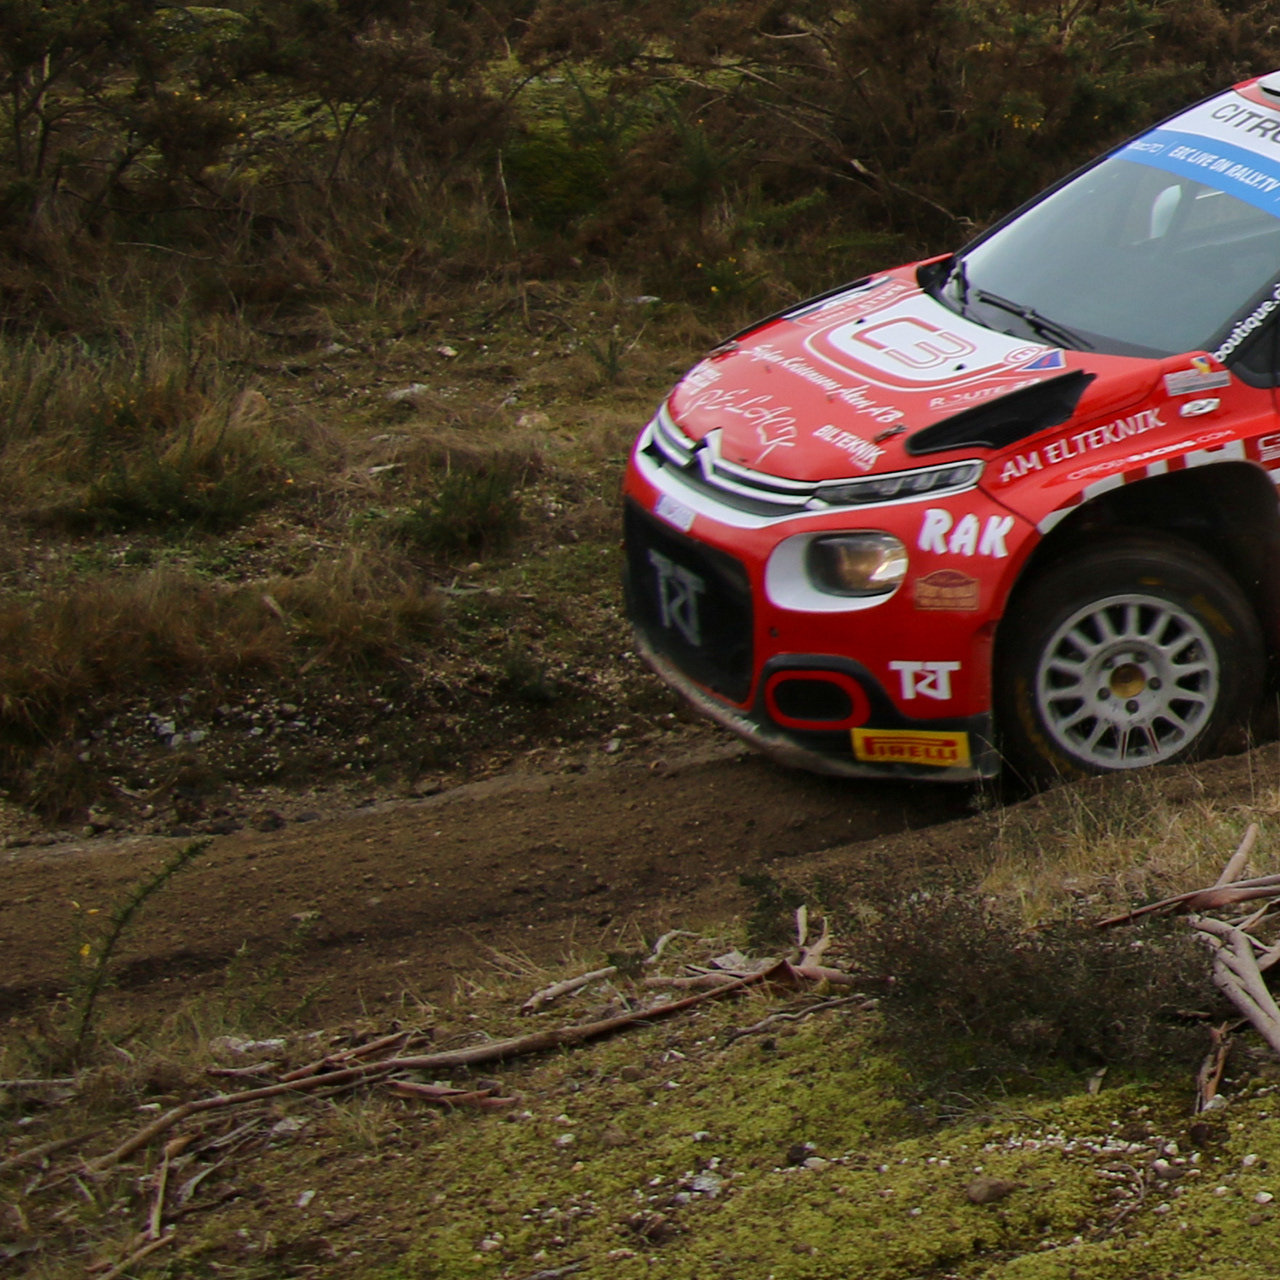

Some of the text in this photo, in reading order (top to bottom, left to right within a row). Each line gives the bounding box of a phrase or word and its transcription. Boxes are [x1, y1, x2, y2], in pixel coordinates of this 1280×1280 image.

[1168, 146, 1188, 160] ERC
[1189, 150, 1211, 168] LIVE
[1209, 157, 1228, 173] ON
[811, 424, 887, 467] BILTEKNIK
[1000, 450, 1043, 483] AM
[1043, 407, 1168, 467] ELTEKNIK
[917, 508, 1015, 558] RAK
[862, 736, 959, 764] PIRELLI
